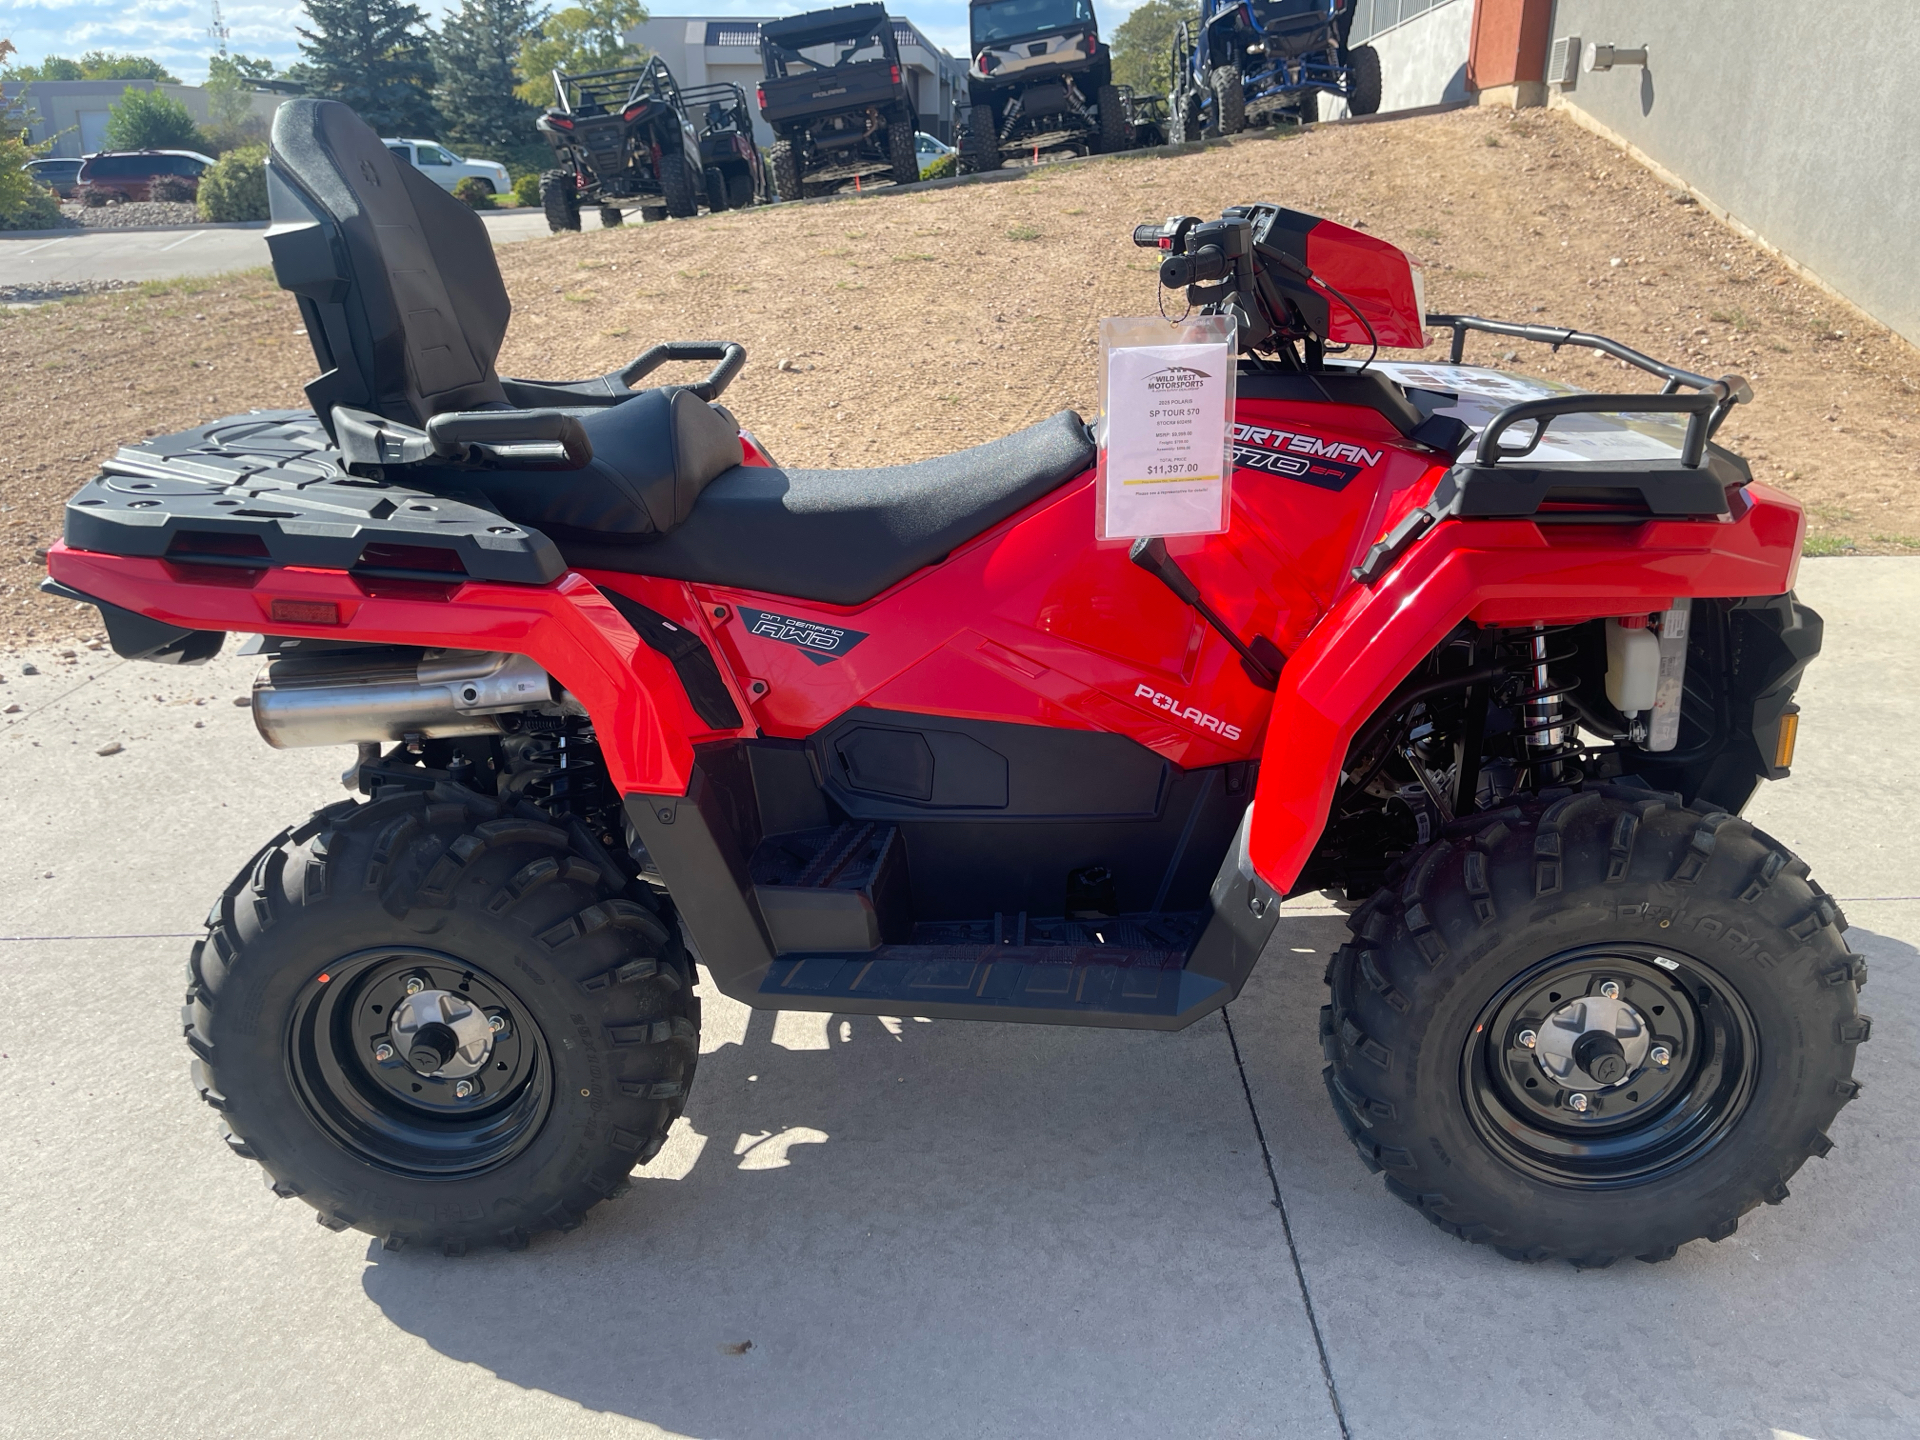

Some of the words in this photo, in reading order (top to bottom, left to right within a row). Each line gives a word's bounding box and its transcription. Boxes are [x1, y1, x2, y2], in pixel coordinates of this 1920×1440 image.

[812, 87, 847, 98] POLARIS
[1148, 380, 1204, 390] MOTORSPORTS
[1176, 374, 1196, 382] WEST
[1162, 409, 1185, 417] TOUR
[1187, 408, 1200, 416] 570
[1233, 423, 1383, 467] ORTSMAN
[1147, 463, 1198, 475] $11,397.00
[1309, 465, 1347, 479] EFI
[785, 619, 845, 636] DEMAND
[752, 620, 840, 650] AWD
[1134, 683, 1242, 741] POLARIS
[1615, 903, 1780, 972] POLARIS
